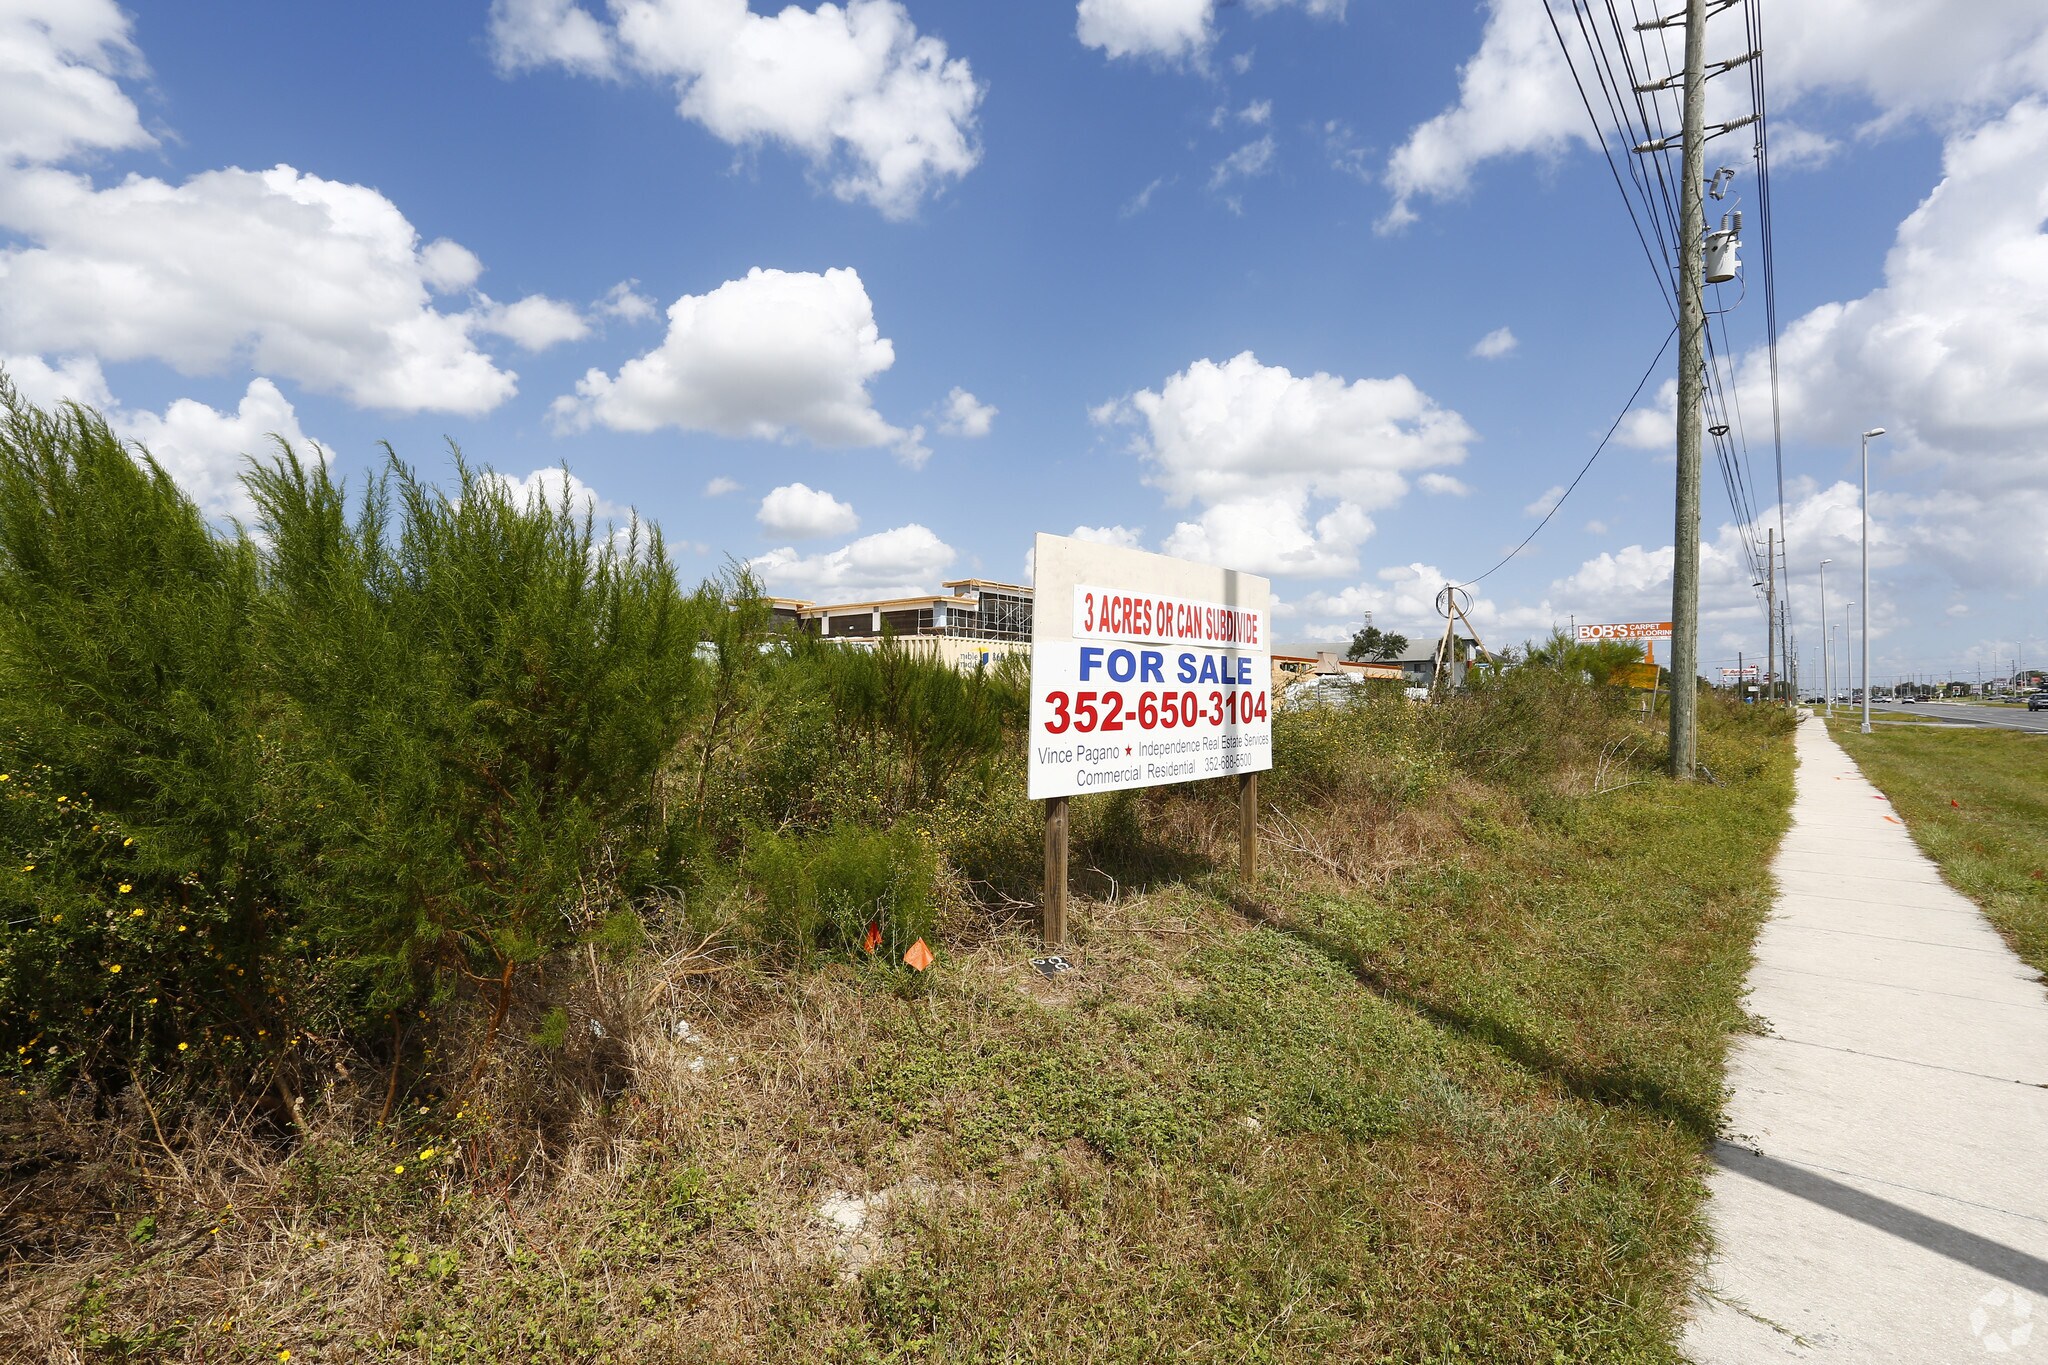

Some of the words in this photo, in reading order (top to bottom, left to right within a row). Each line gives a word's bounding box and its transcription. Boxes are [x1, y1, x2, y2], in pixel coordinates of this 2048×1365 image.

[1084, 592, 1094, 632] 3
[1099, 595, 1152, 636] ACRES
[1156, 601, 1174, 637] OR
[1177, 603, 1202, 639] CAN
[1206, 607, 1258, 645] SUBDIVIDE
[1579, 625, 1628, 638] BOB'S
[1079, 646, 1165, 683] FOR
[1177, 652, 1252, 685] SALE
[1044, 690, 1267, 735] 352-650-3104
[1038, 747, 1073, 765] Vince
[1077, 744, 1120, 764] Pagano
[1138, 737, 1200, 758] Independence
[1202, 735, 1219, 750] Real
[1221, 734, 1242, 749] Estate
[1244, 732, 1269, 747] Services
[1076, 766, 1142, 787] Commercial
[1147, 759, 1196, 780] Residential
[1204, 752, 1252, 772] 352-688-5500
